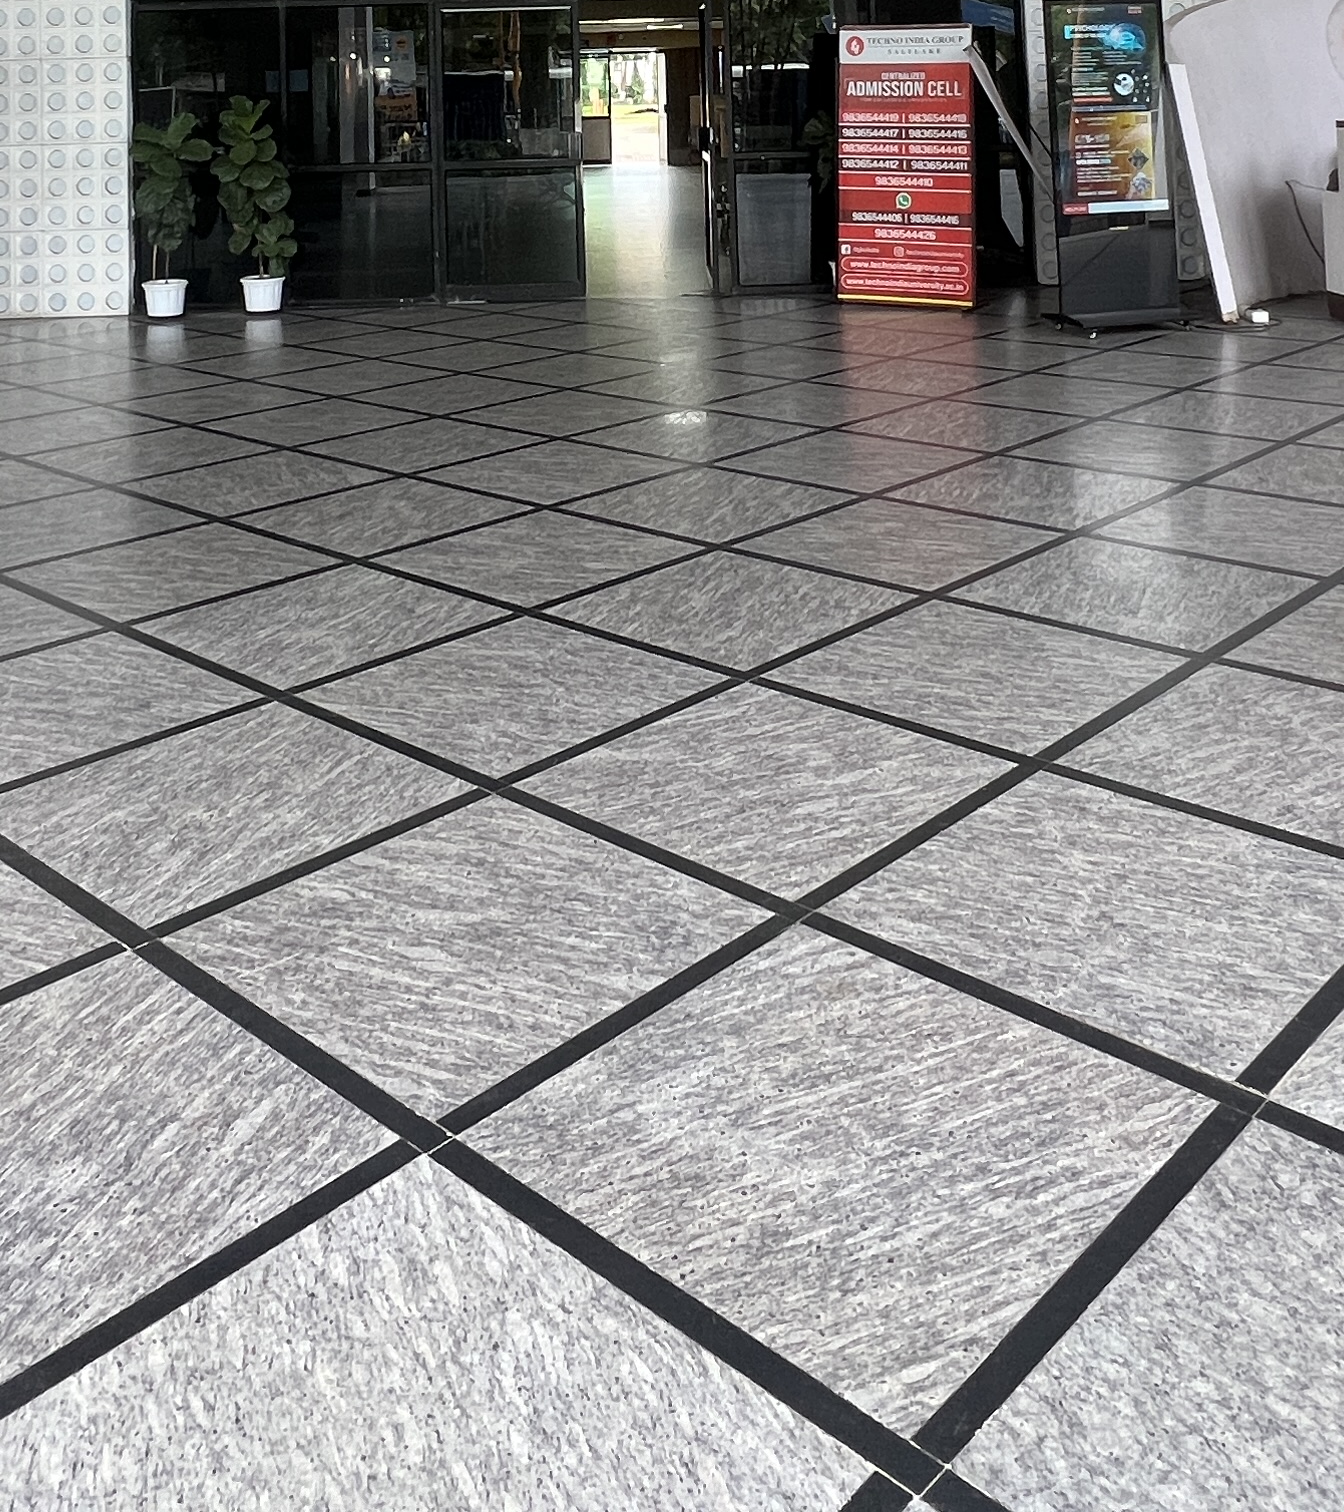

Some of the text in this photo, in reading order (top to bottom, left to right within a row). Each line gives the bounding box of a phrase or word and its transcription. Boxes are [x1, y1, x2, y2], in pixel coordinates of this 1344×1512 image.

[866, 35, 964, 45] TECHNO INDIA GROUP
[881, 71, 926, 80] CENTRALIZED
[846, 80, 962, 97] ADMISSION CELL
